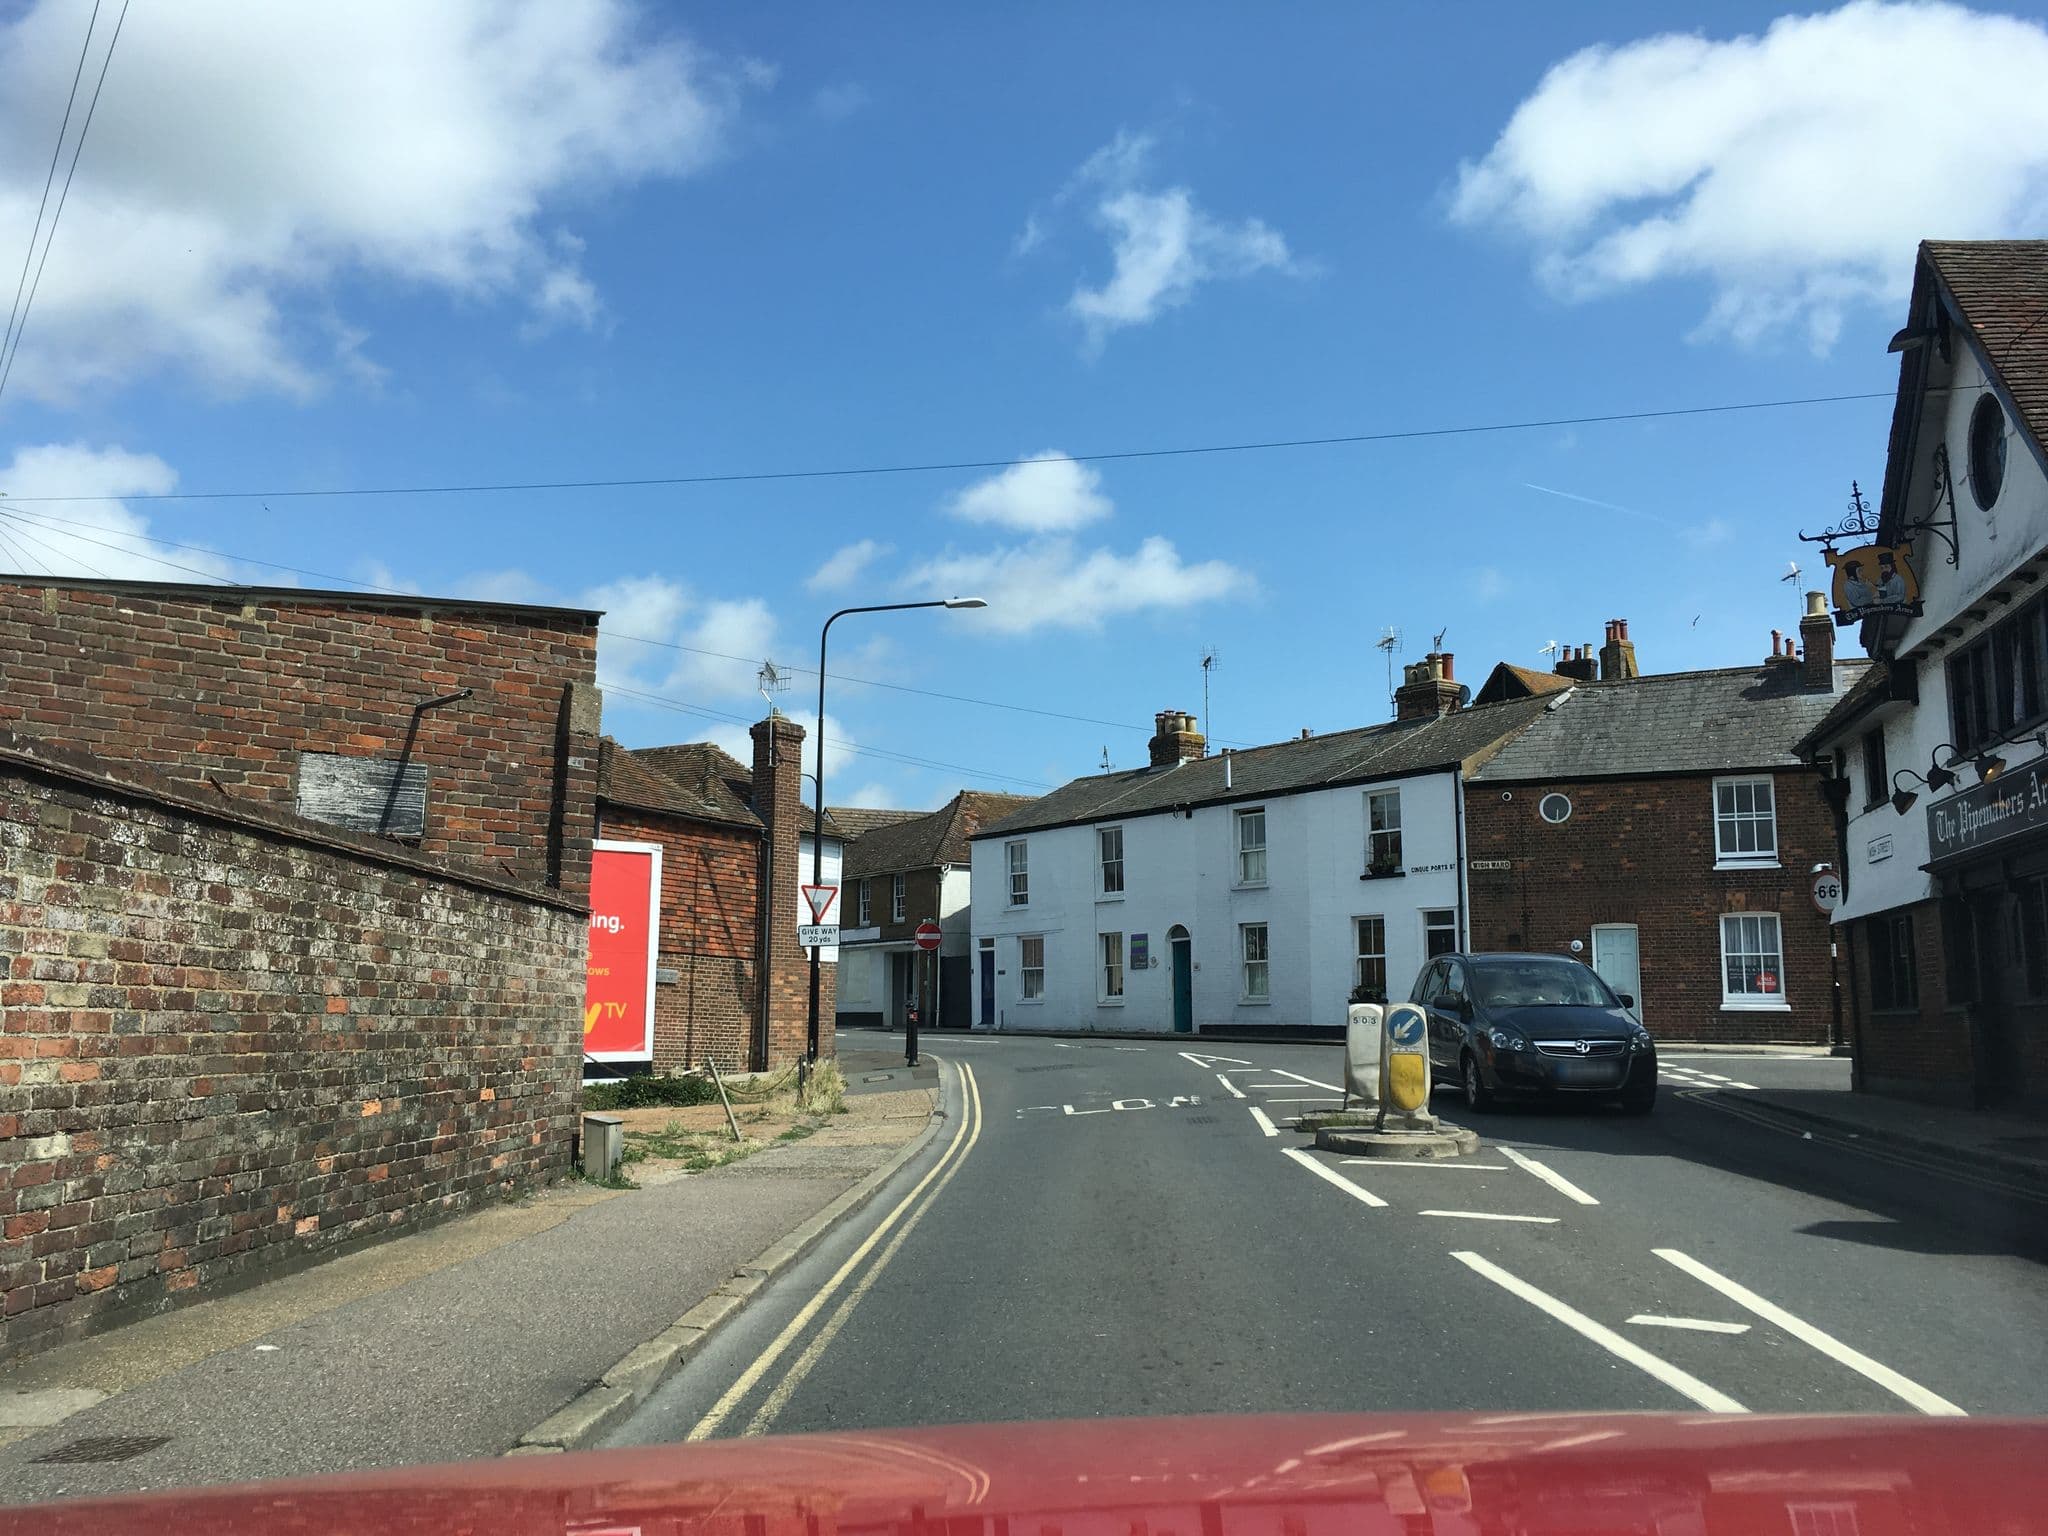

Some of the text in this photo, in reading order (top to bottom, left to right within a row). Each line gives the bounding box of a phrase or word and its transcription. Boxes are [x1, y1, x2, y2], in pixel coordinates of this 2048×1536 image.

[1936, 810, 1956, 848] The
[1957, 787, 2024, 843] Pipemakers
[591, 910, 625, 934] ing.
[819, 936, 831, 944] yds
[604, 1002, 627, 1019] TV
[1353, 1015, 1378, 1025] 503
